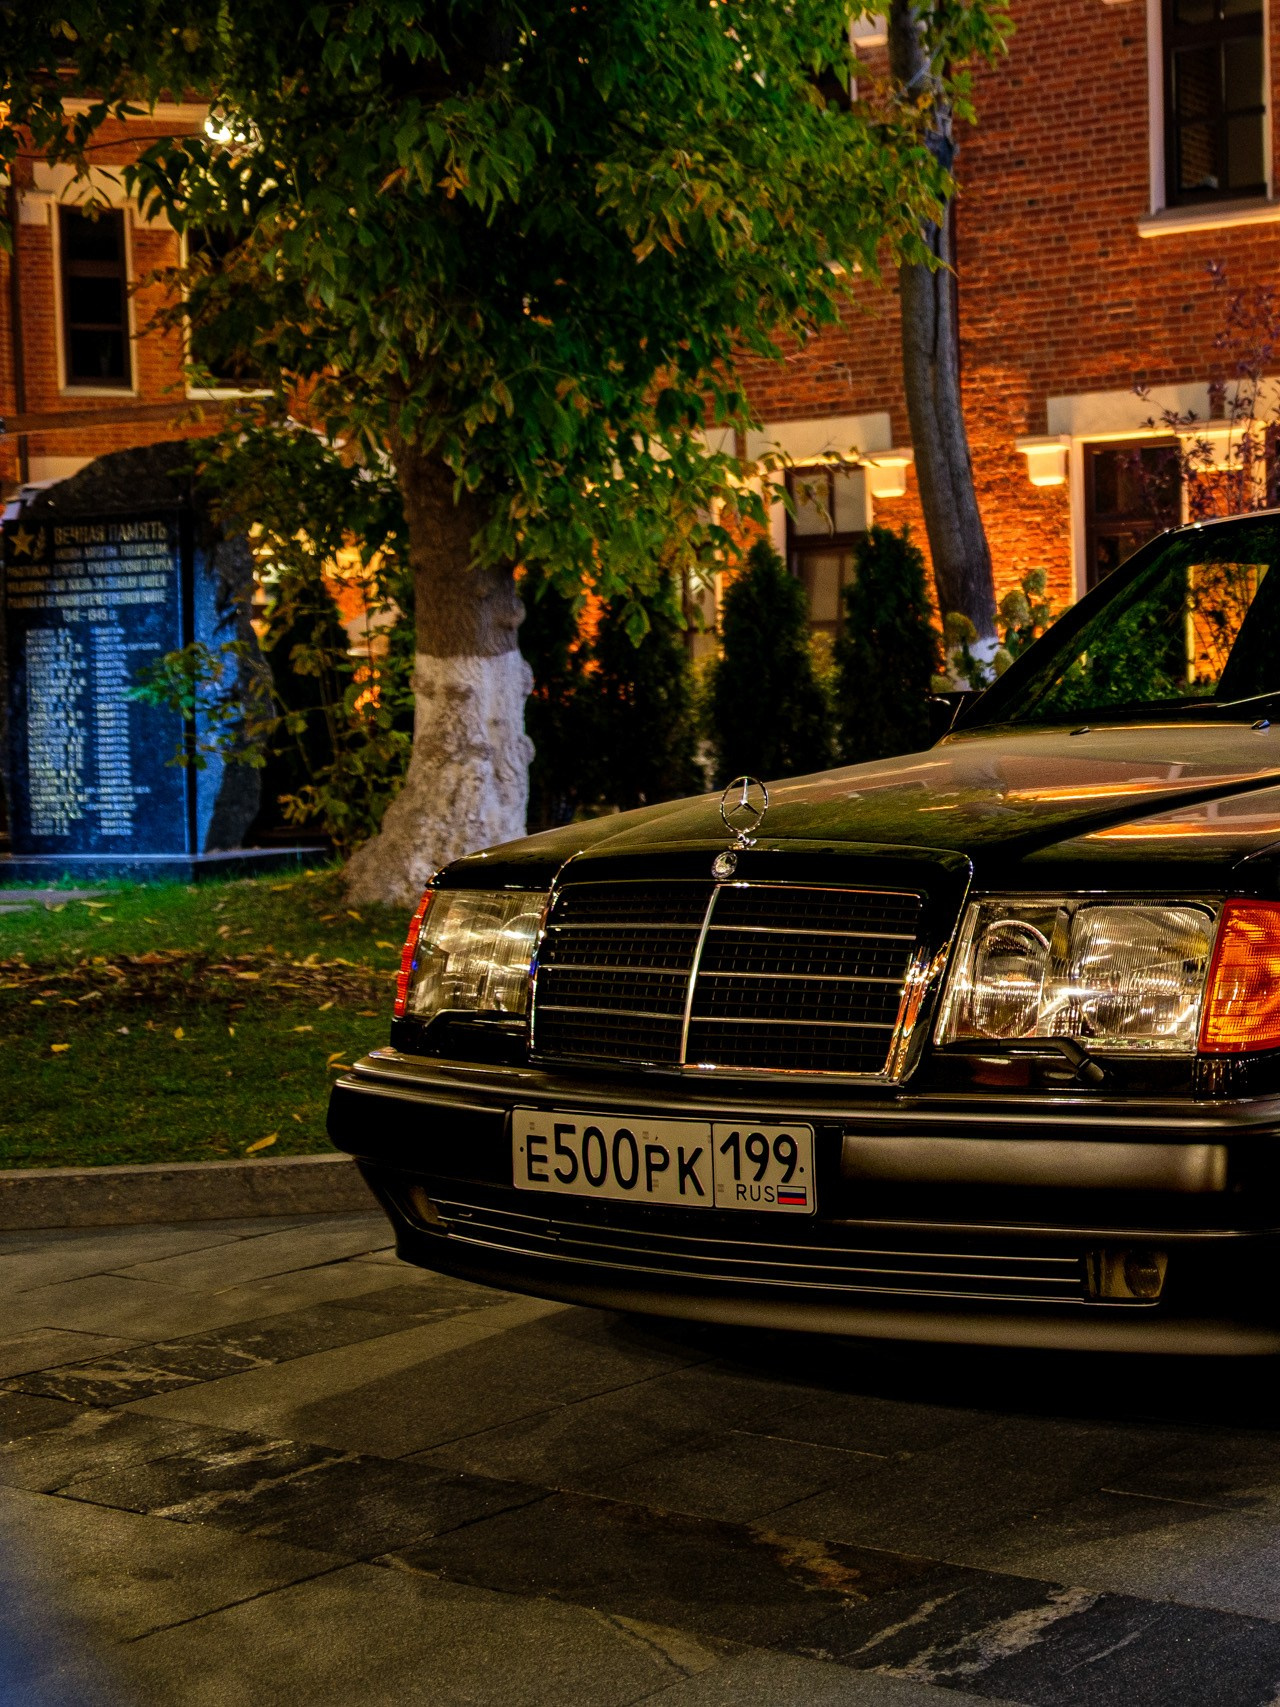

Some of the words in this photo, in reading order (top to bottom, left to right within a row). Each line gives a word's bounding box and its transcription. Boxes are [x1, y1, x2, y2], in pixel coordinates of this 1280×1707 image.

[54, 525, 105, 545] ВЕЧНАЯ
[108, 521, 168, 542] ПАМЯТЬ
[719, 1131, 799, 1184] 199
[736, 1184, 776, 1202] RUS
